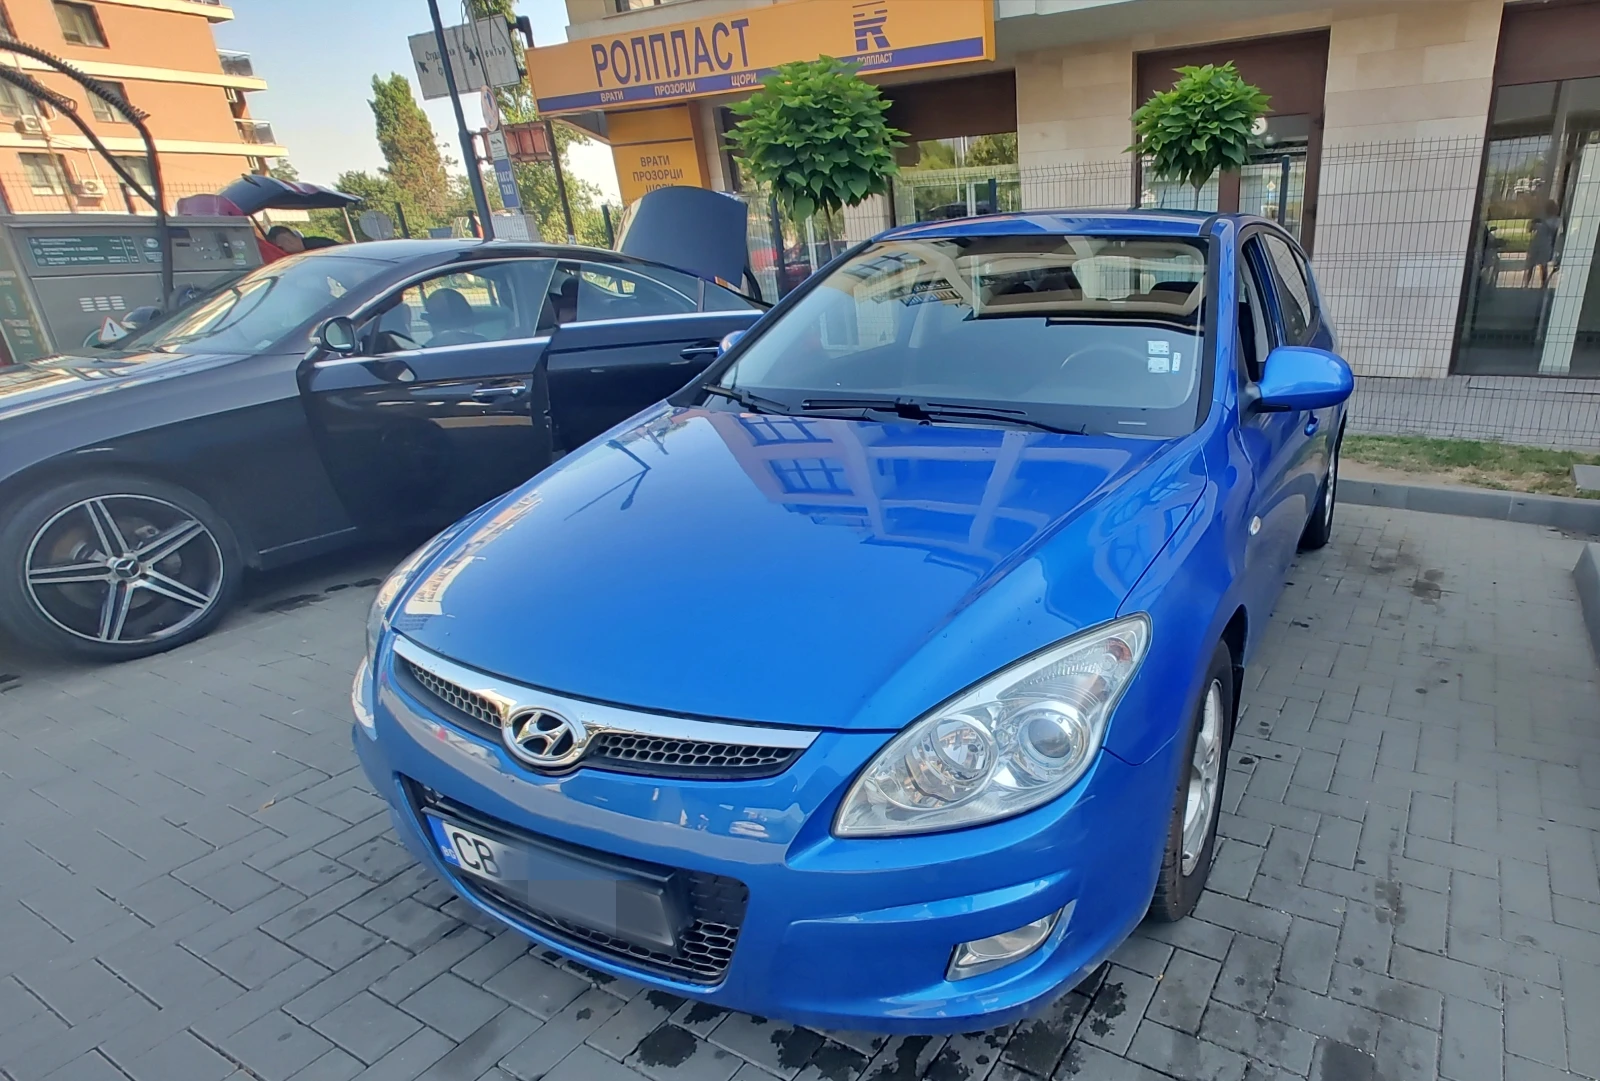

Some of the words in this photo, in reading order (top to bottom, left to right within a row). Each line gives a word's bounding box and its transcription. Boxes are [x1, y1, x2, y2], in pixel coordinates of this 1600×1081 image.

[591, 18, 749, 88] РОЛПЛАСТ
[600, 91, 624, 103] ВРАТИ
[655, 81, 696, 97] ПРОЗОРЦИ
[731, 72, 757, 87] ЩОРИ
[640, 155, 671, 168] ВРАТИ
[632, 168, 684, 182] ПРОЗОРЦИ
